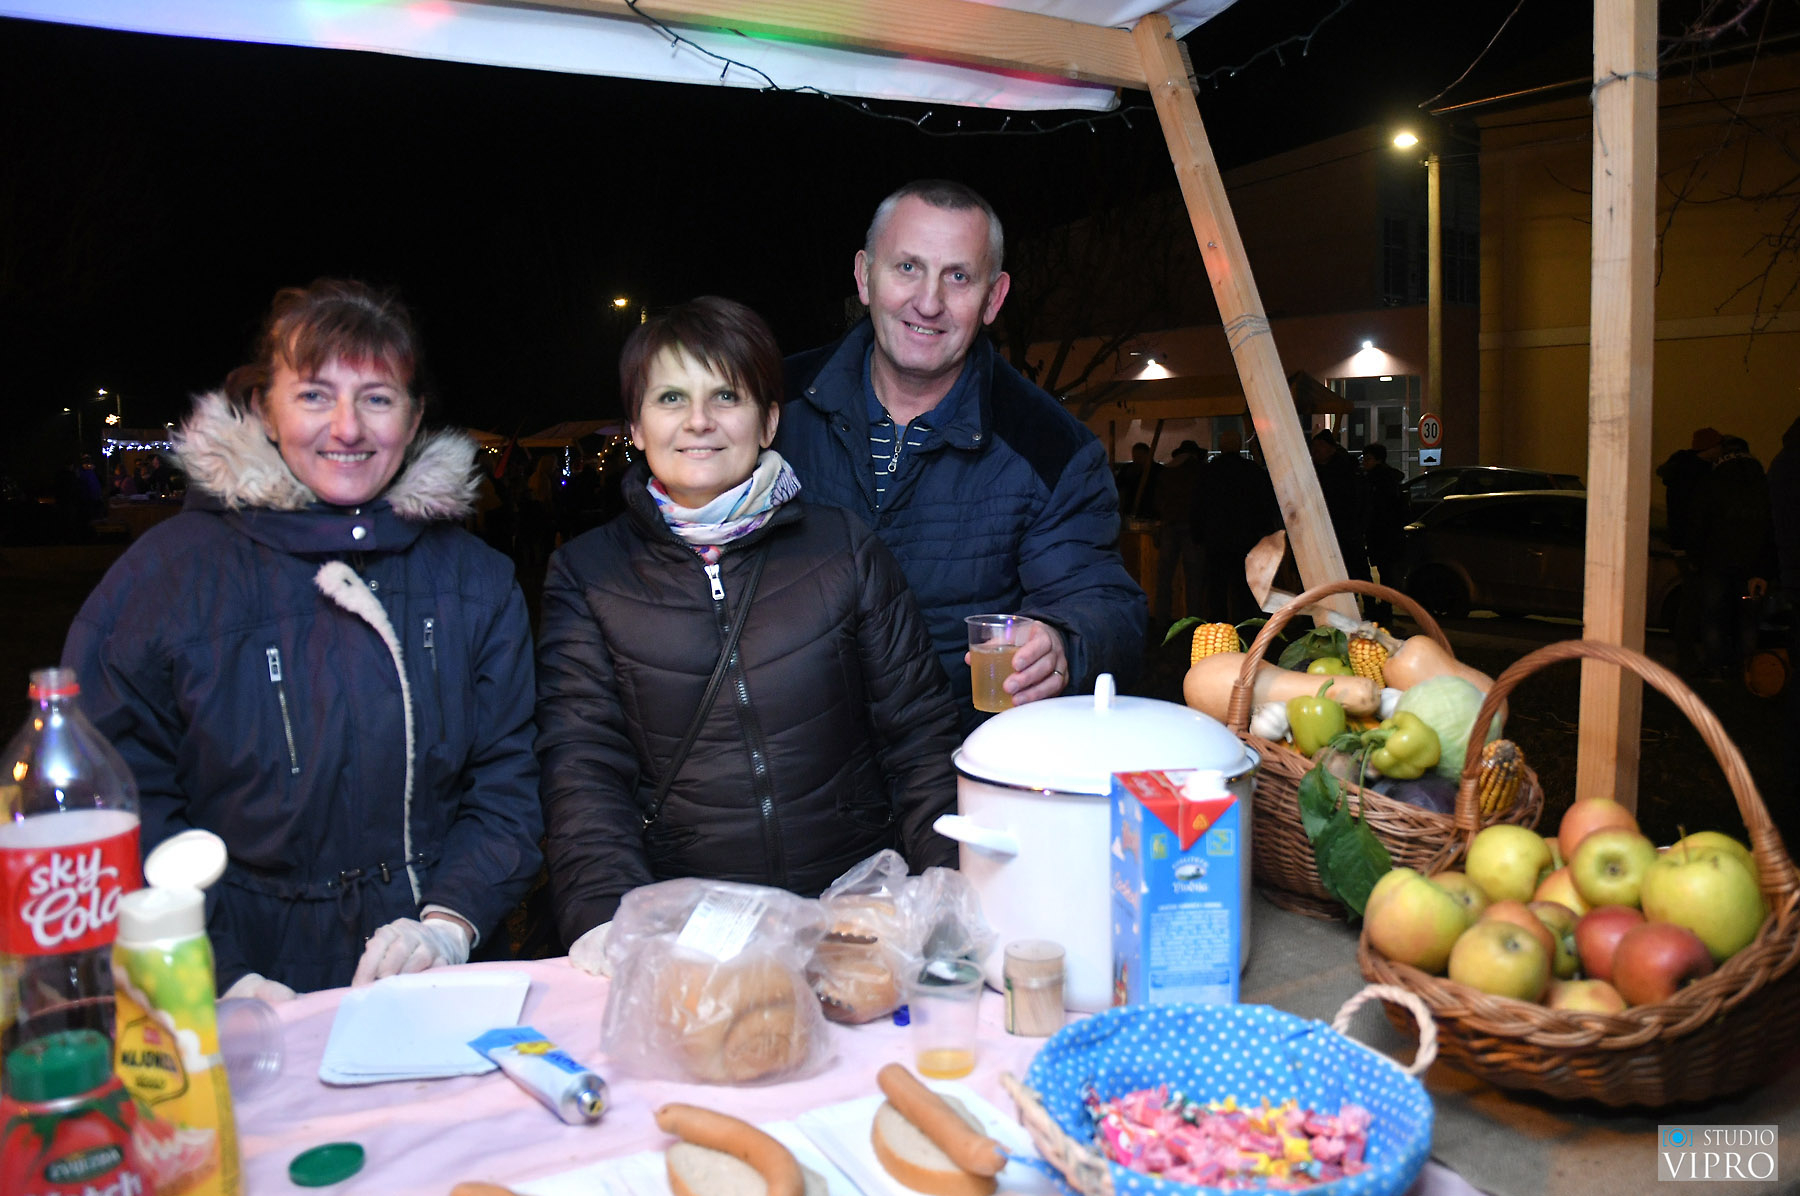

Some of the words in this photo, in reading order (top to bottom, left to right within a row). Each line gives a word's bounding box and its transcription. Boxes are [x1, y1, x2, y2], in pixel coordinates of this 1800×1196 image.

[1423, 422, 1438, 439] 30
[28, 847, 118, 895] sky
[21, 887, 122, 948] Cola
